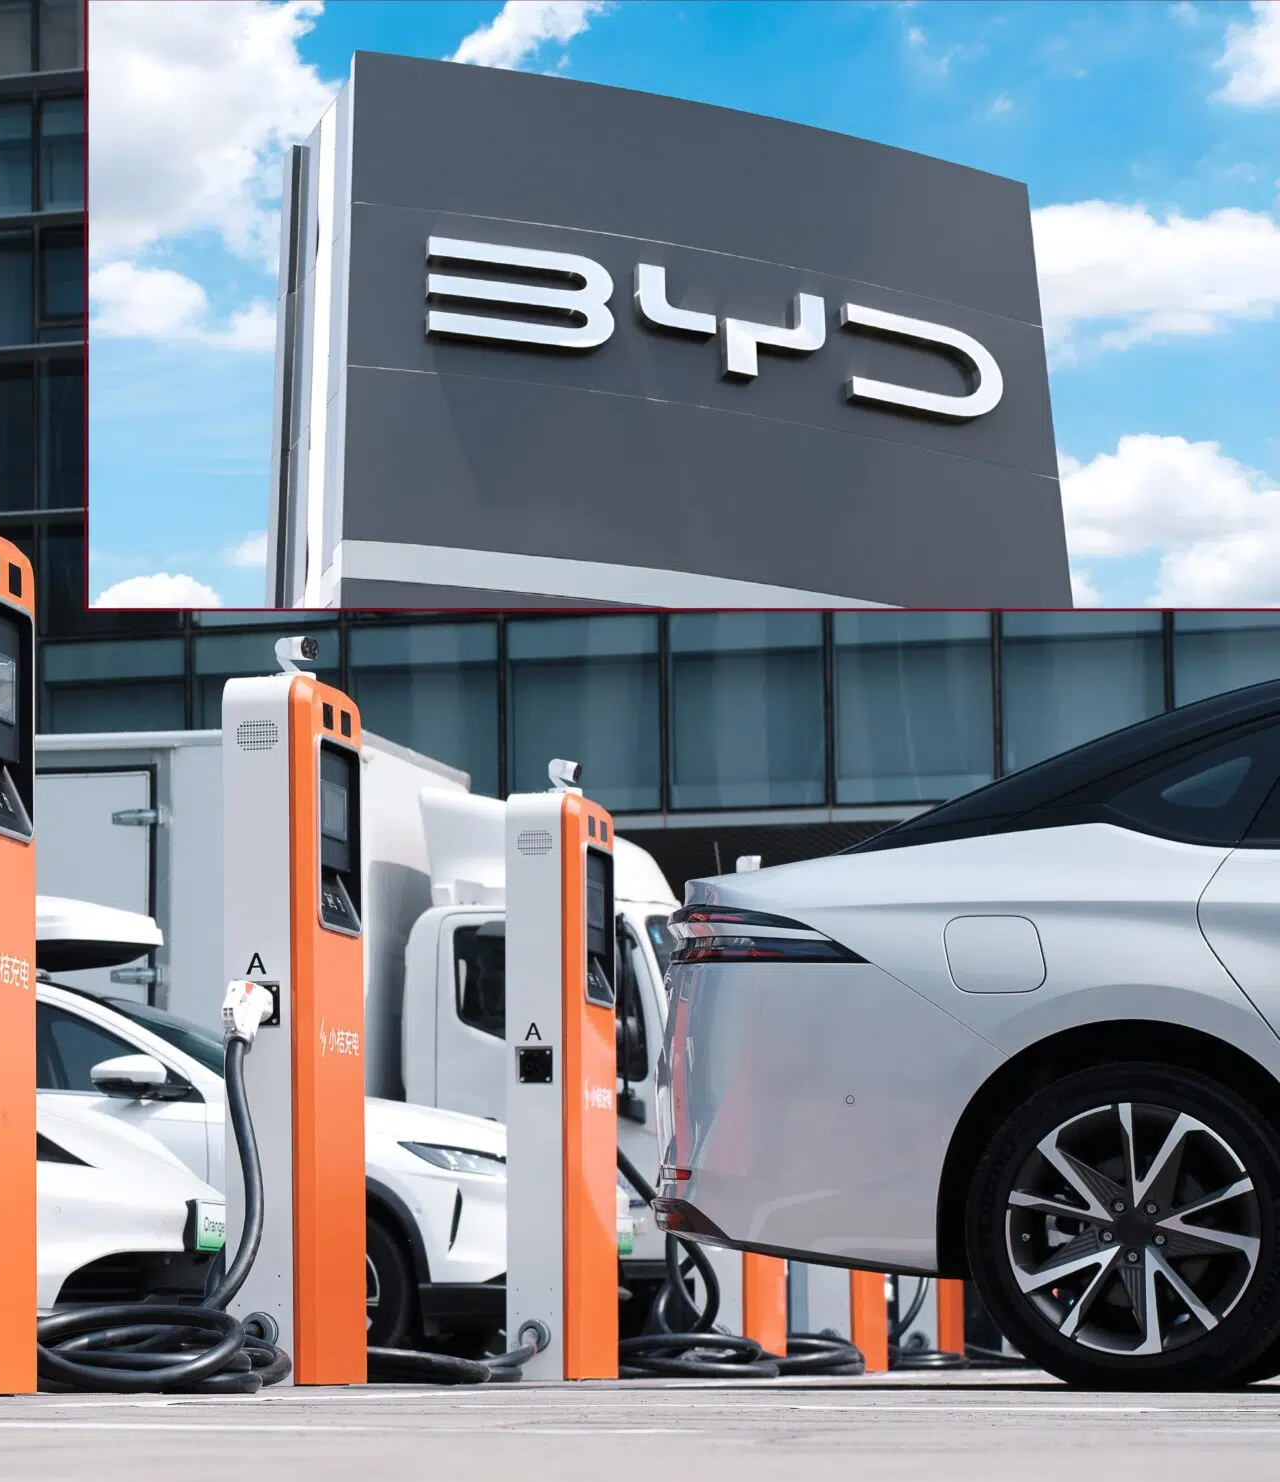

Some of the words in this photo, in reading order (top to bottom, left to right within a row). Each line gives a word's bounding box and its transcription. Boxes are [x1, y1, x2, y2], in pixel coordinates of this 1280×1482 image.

[425, 236, 1004, 417] BYD
[246, 953, 267, 975] A
[525, 1022, 542, 1041] A
